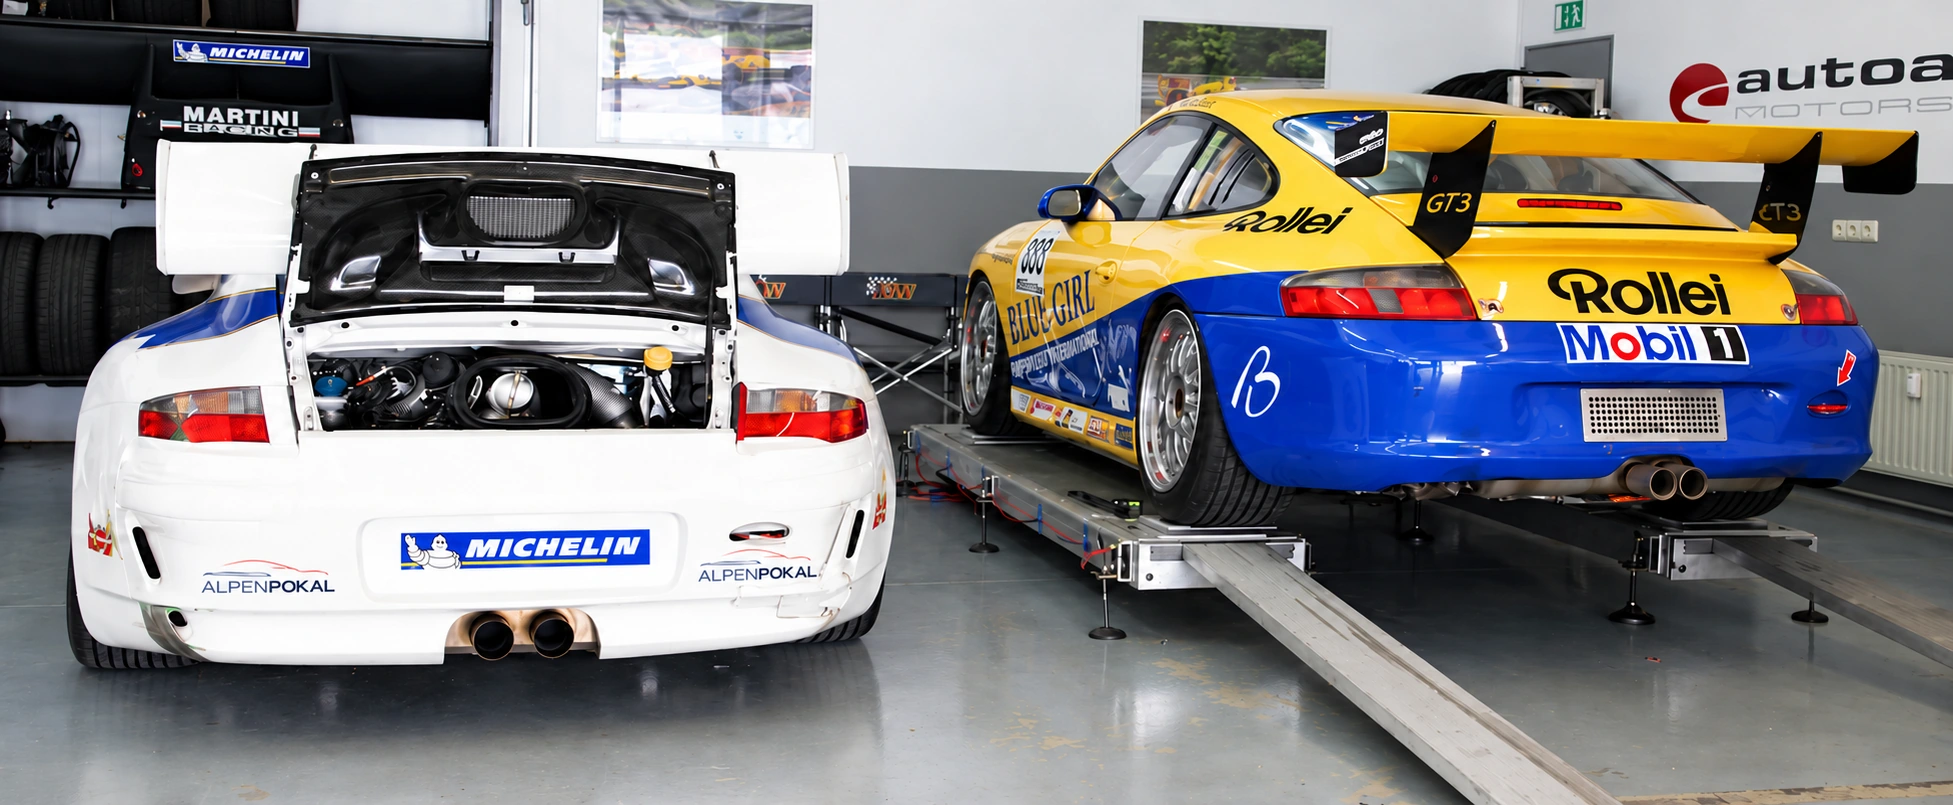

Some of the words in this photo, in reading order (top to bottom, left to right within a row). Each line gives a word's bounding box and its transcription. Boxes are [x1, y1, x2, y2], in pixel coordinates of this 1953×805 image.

[209, 47, 305, 61] MICHELIN
[183, 105, 299, 127] MARTINI
[1735, 96, 1953, 119] MOTORS
[183, 122, 299, 138] RACING
[1426, 192, 1473, 214] GT3
[1222, 206, 1354, 235] Rollei
[1021, 237, 1055, 276] 888
[1547, 267, 1732, 316] Rollei
[1006, 288, 1053, 346] BLUE
[1052, 269, 1096, 327] GIRL
[1560, 324, 1698, 362] Mobil
[1712, 327, 1734, 360] 1
[464, 536, 641, 558] MICHELIN
[698, 564, 818, 583] ALPENPOKAL
[201, 579, 336, 594] ALPENPOKAL
